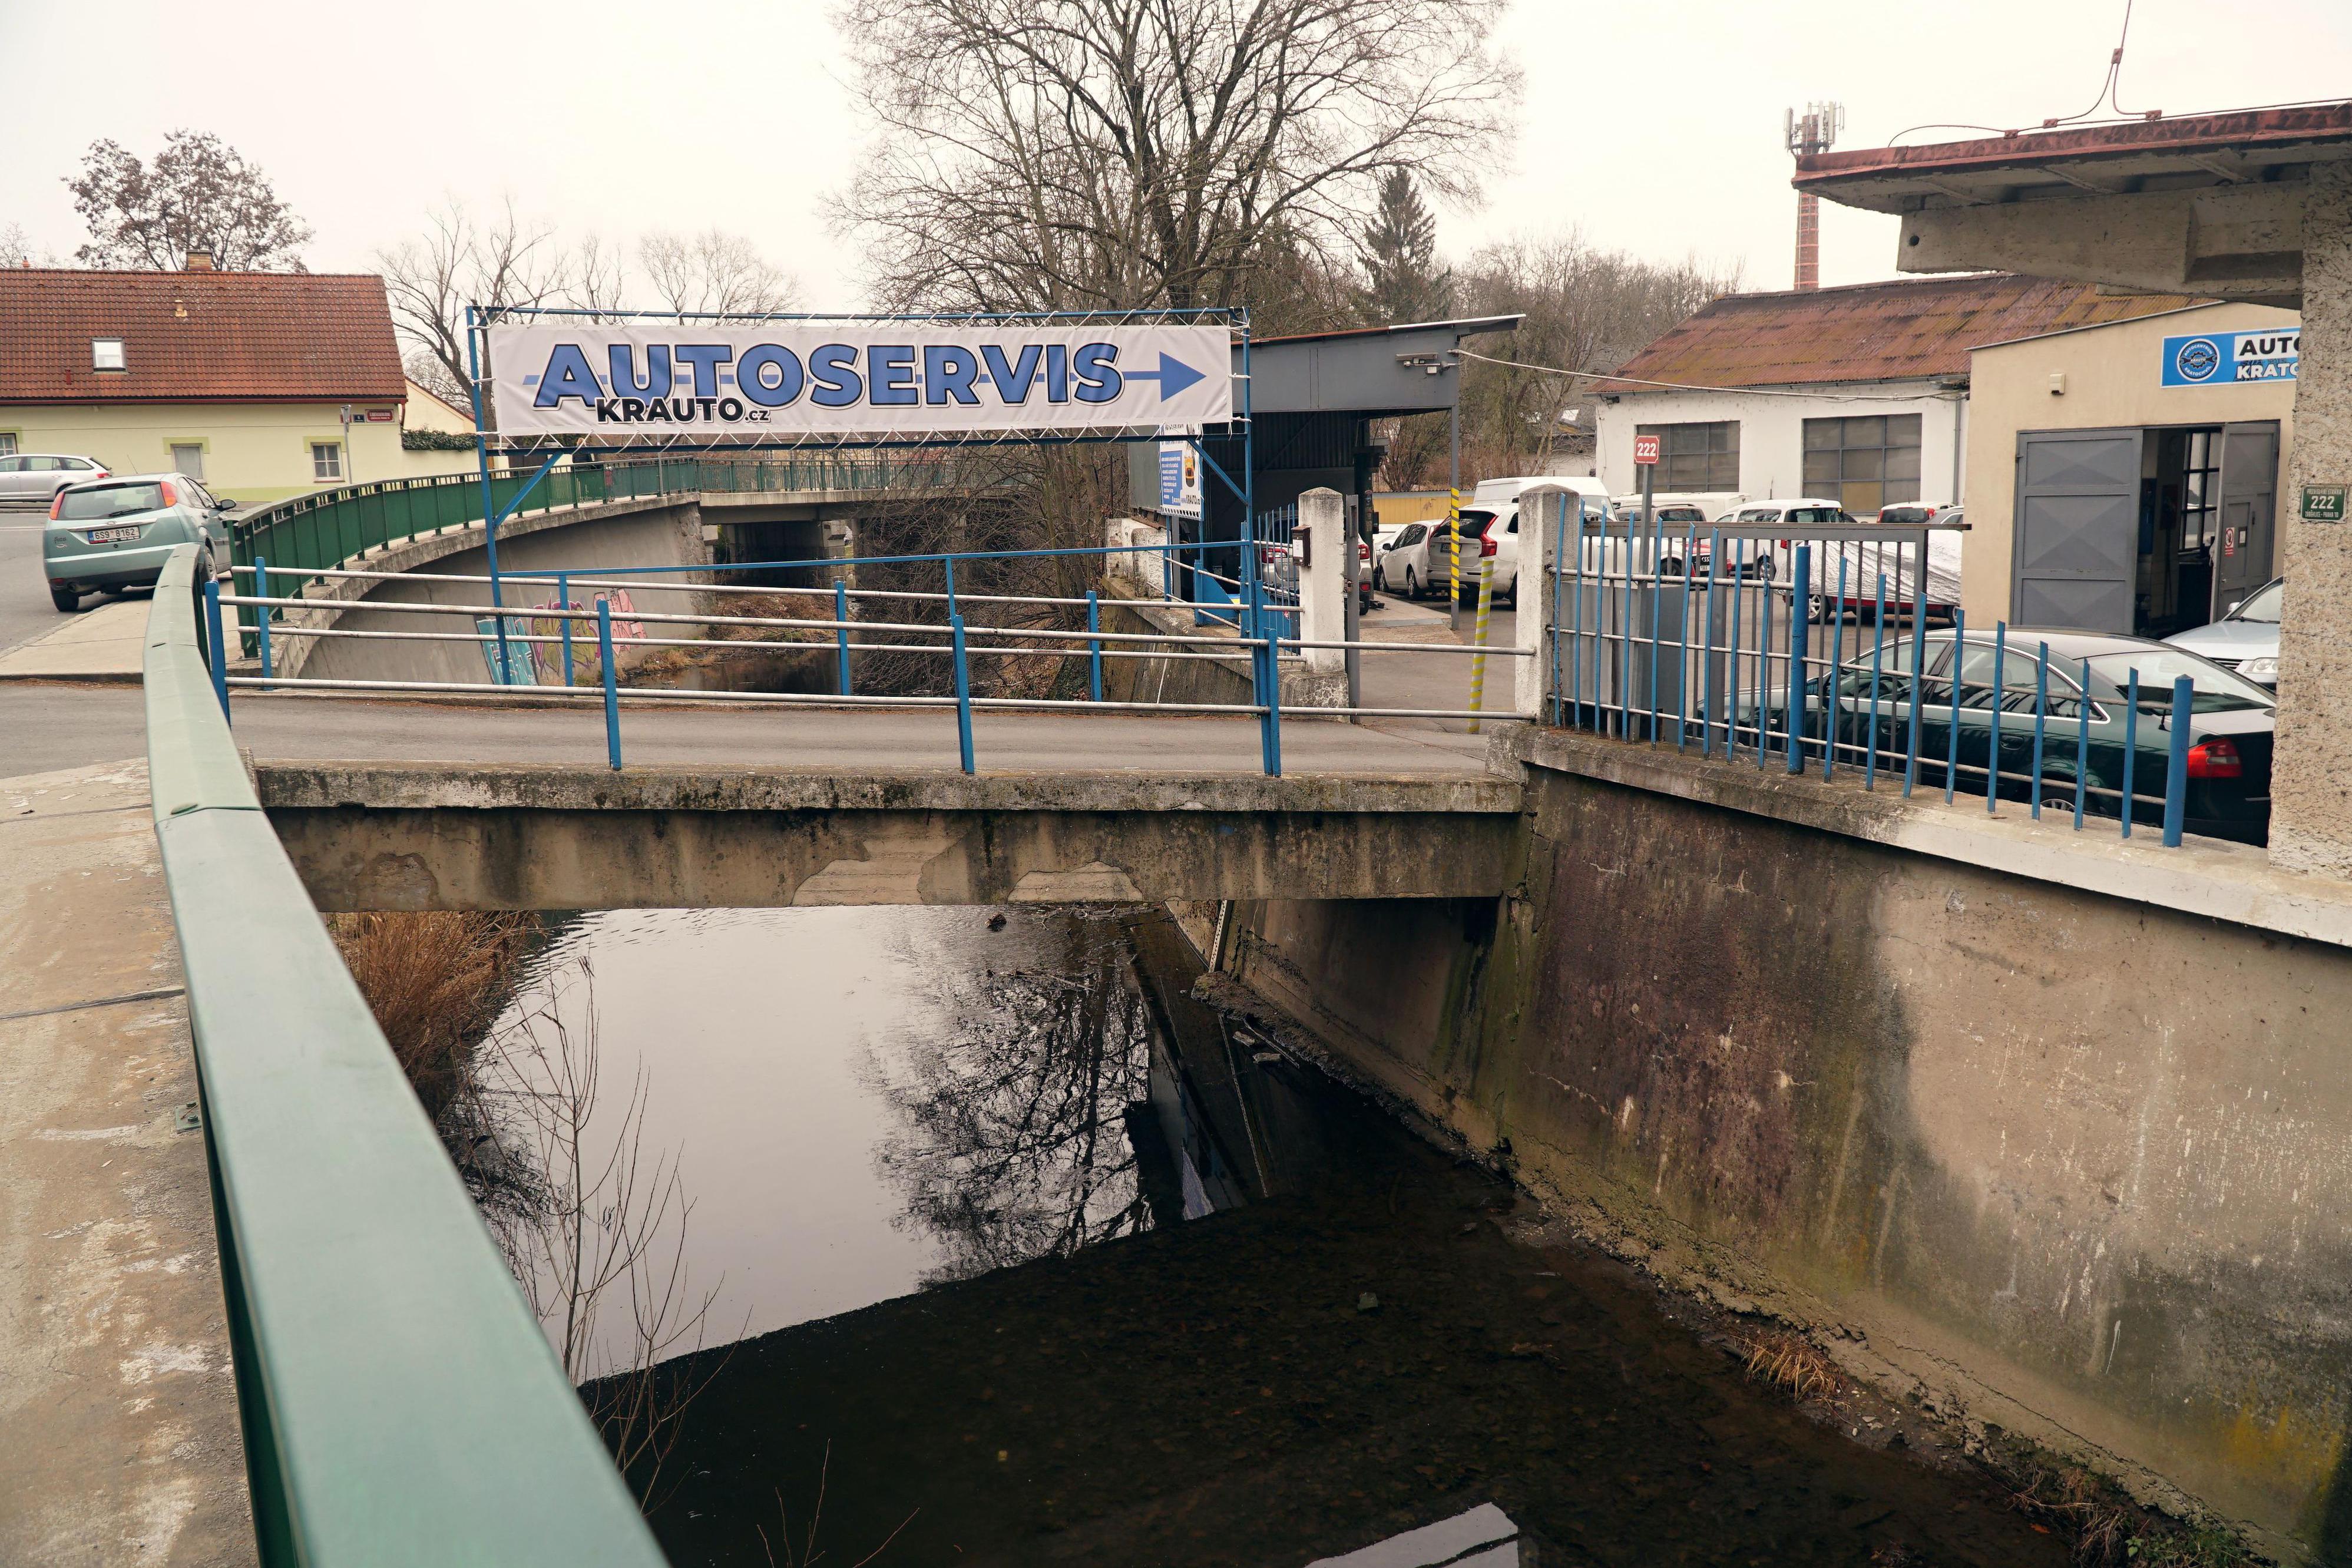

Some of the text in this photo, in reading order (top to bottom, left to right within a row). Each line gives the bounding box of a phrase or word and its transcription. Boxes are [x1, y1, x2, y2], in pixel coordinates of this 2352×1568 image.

[2184, 344, 2213, 356] AUTOCENTRUM
[533, 342, 1125, 408] AUTOSERVIS
[1637, 442, 1656, 456] 222
[2310, 495, 2335, 509] 222
[94, 528, 135, 540] 6S9 8162
